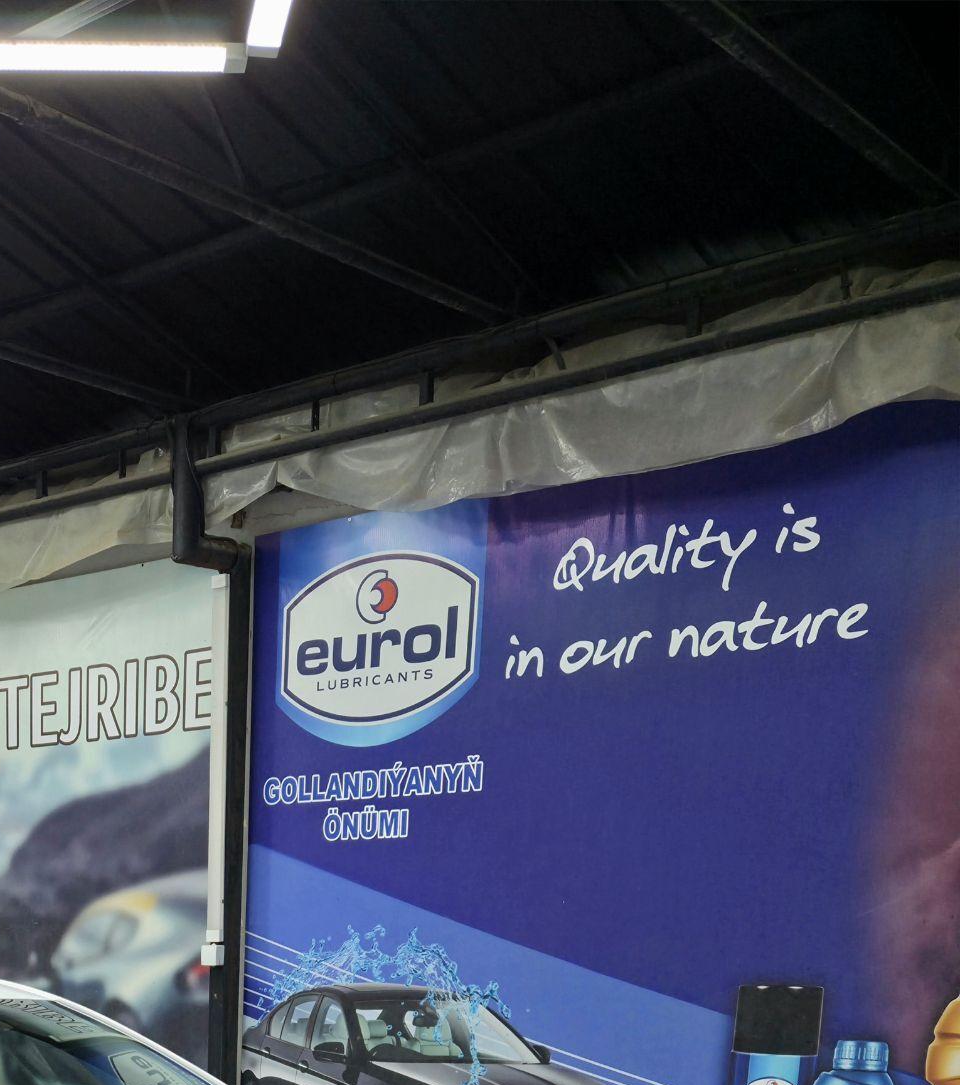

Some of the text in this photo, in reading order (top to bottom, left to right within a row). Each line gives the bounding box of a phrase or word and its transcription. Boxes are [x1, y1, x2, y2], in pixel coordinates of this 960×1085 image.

[553, 503, 821, 591] Quality is
[297, 605, 458, 676] eurol
[504, 601, 870, 679] in our nature
[316, 669, 434, 692] LUBRICANTS
[323, 805, 410, 841] ÖNÜMI
